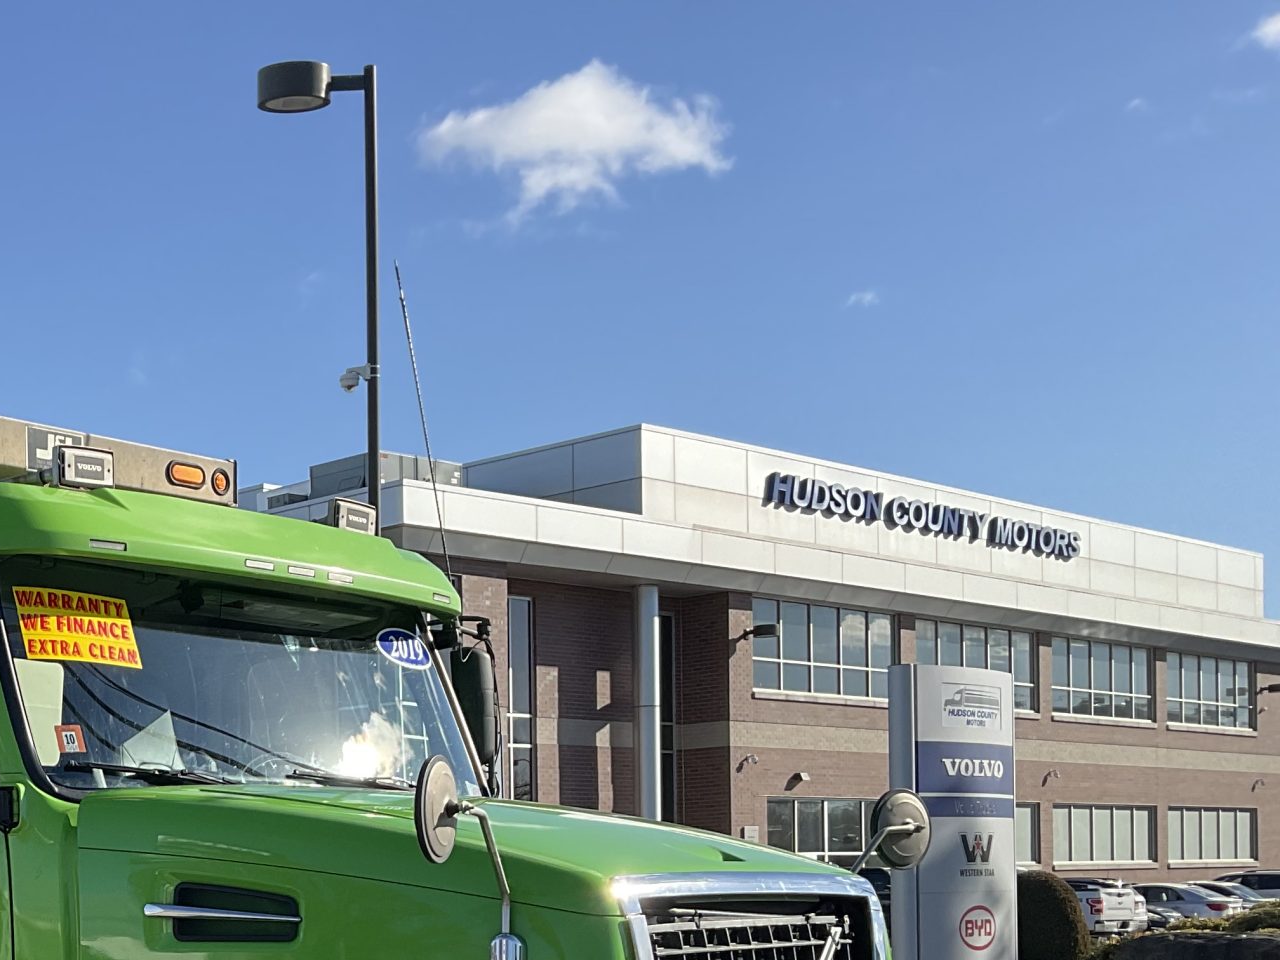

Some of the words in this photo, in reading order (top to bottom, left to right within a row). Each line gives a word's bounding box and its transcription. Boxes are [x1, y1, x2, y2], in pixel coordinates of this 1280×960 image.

[77, 463, 102, 472] VOLVO
[348, 514, 367, 524] VOLVO
[769, 471, 883, 522] HUDSON
[887, 496, 990, 540] COUNTY
[992, 516, 1082, 561] MOTORS
[15, 590, 124, 617] WARRANTY
[21, 613, 51, 632] WE
[56, 614, 130, 641] FINANCE
[27, 638, 82, 656] EXTRA
[88, 642, 139, 665] CLEAN
[389, 635, 424, 661] 2019
[948, 708, 976, 717] HUDSON
[976, 710, 997, 719] COUNTY
[966, 719, 985, 727] MOTORS
[64, 733, 75, 745] 10
[942, 758, 1003, 778] VOLVO
[959, 868, 983, 877] WESTERN
[984, 869, 995, 877] STAR
[964, 919, 992, 937] BYD
